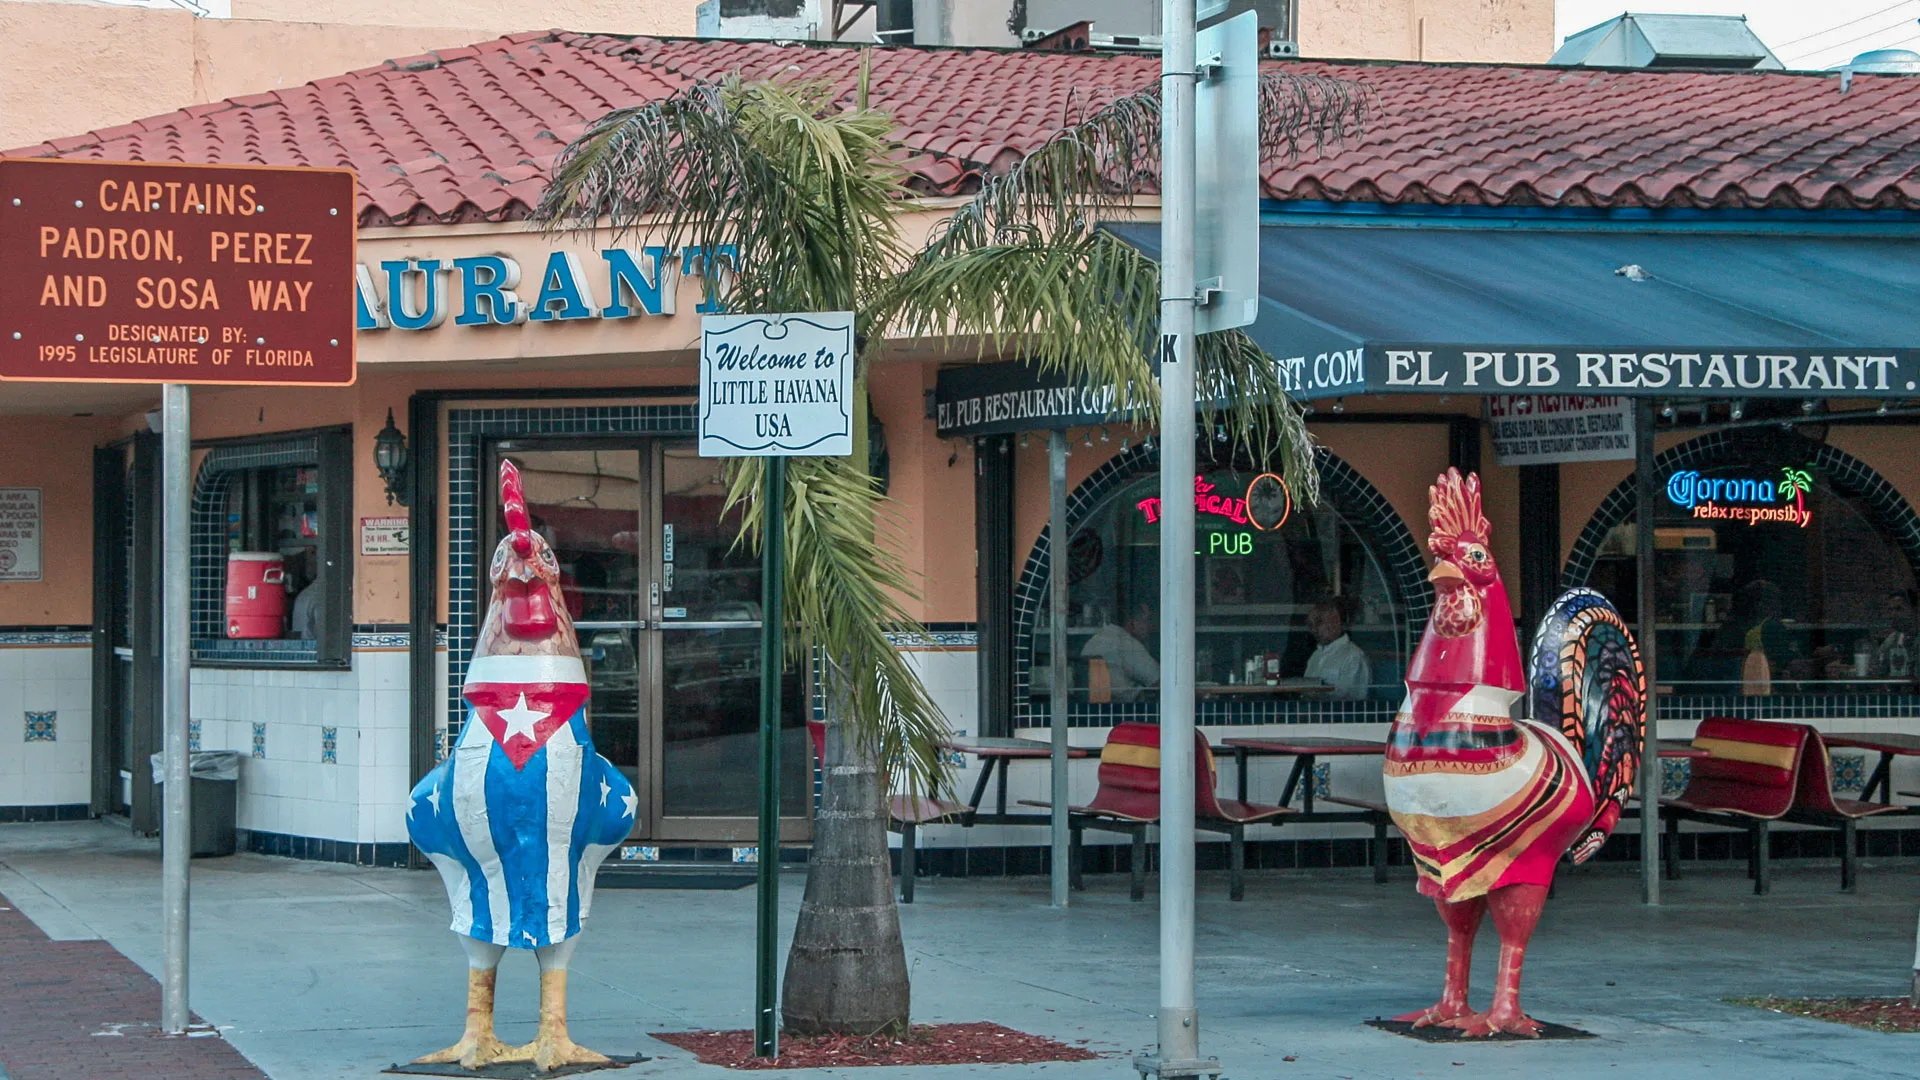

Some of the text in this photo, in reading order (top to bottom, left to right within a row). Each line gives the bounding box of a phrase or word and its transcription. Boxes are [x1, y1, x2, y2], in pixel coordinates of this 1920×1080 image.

[100, 180, 257, 216] CAPTAINS
[40, 226, 313, 265] PADRON, PEREZ
[40, 275, 313, 313] AND SOSA WAY
[108, 324, 247, 344] DESIGNATED BY:
[39, 345, 314, 367] 1995 LEGISLATURE OF FLORIDA
[715, 343, 835, 371] Welcome to
[1385, 350, 1449, 387] EL
[1463, 351, 1561, 388] PUB
[712, 378, 838, 405] LITTLE HAVANA
[755, 413, 792, 437] USA
[937, 403, 955, 429] EL
[956, 397, 981, 427] PUB
[1667, 470, 1775, 509] Corona
[365, 519, 409, 527] WARNING
[1138, 494, 1249, 525] TICAL
[1693, 501, 1812, 528] relax responsibly
[365, 535, 376, 543] 24
[1210, 532, 1253, 555] PUB
